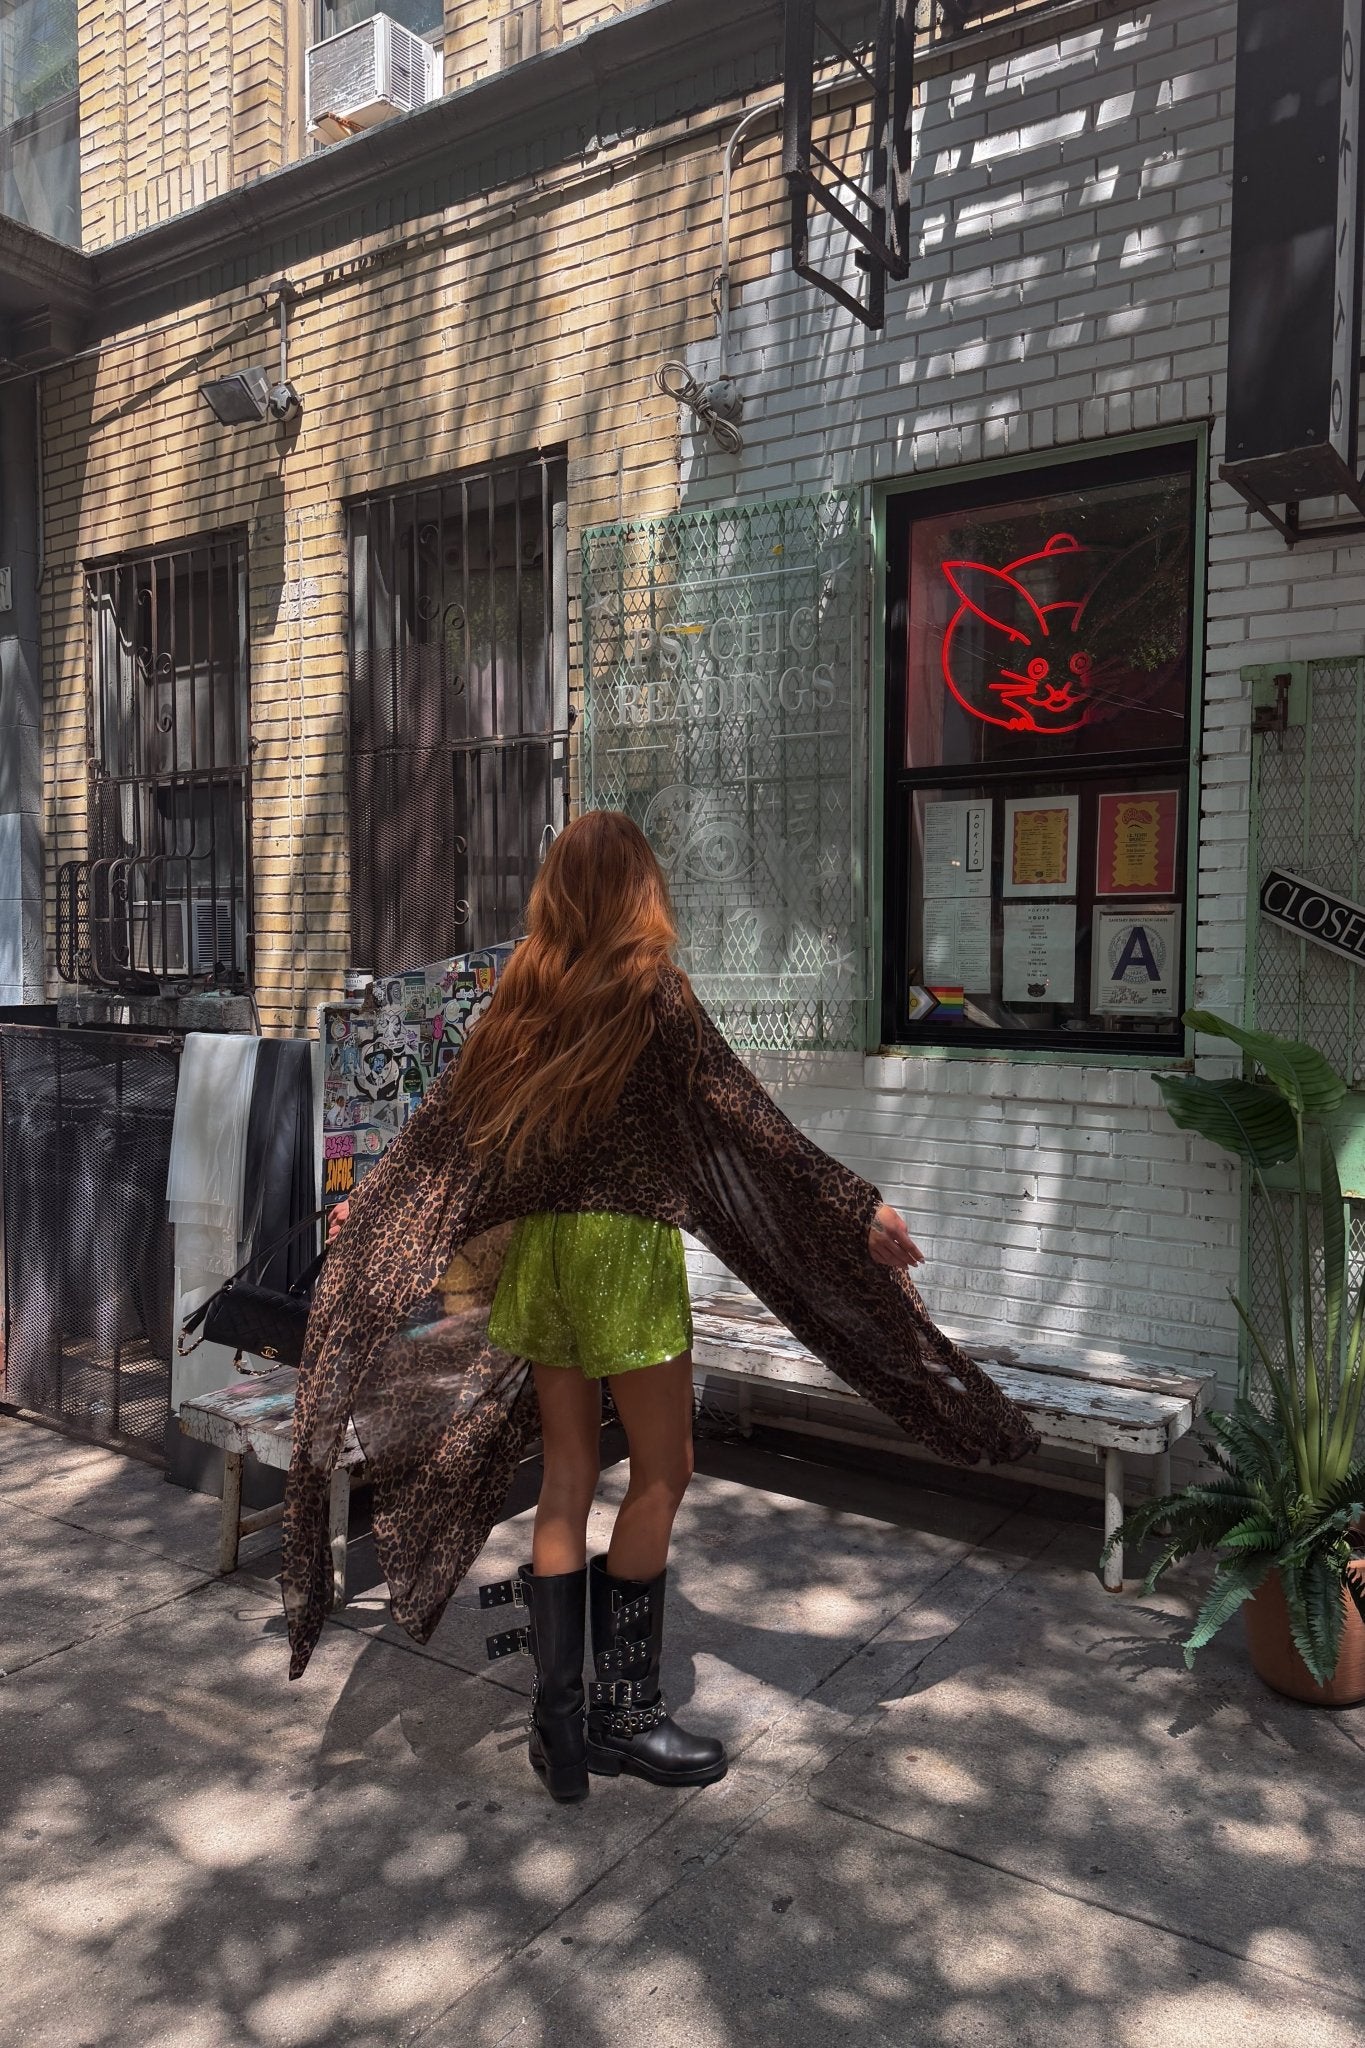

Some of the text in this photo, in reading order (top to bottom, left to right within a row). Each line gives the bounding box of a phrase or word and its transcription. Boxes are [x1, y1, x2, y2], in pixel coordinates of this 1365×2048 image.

[629, 605, 818, 670] PSYCHIC
[614, 662, 836, 727] READINGS
[1111, 926, 1161, 982] A
